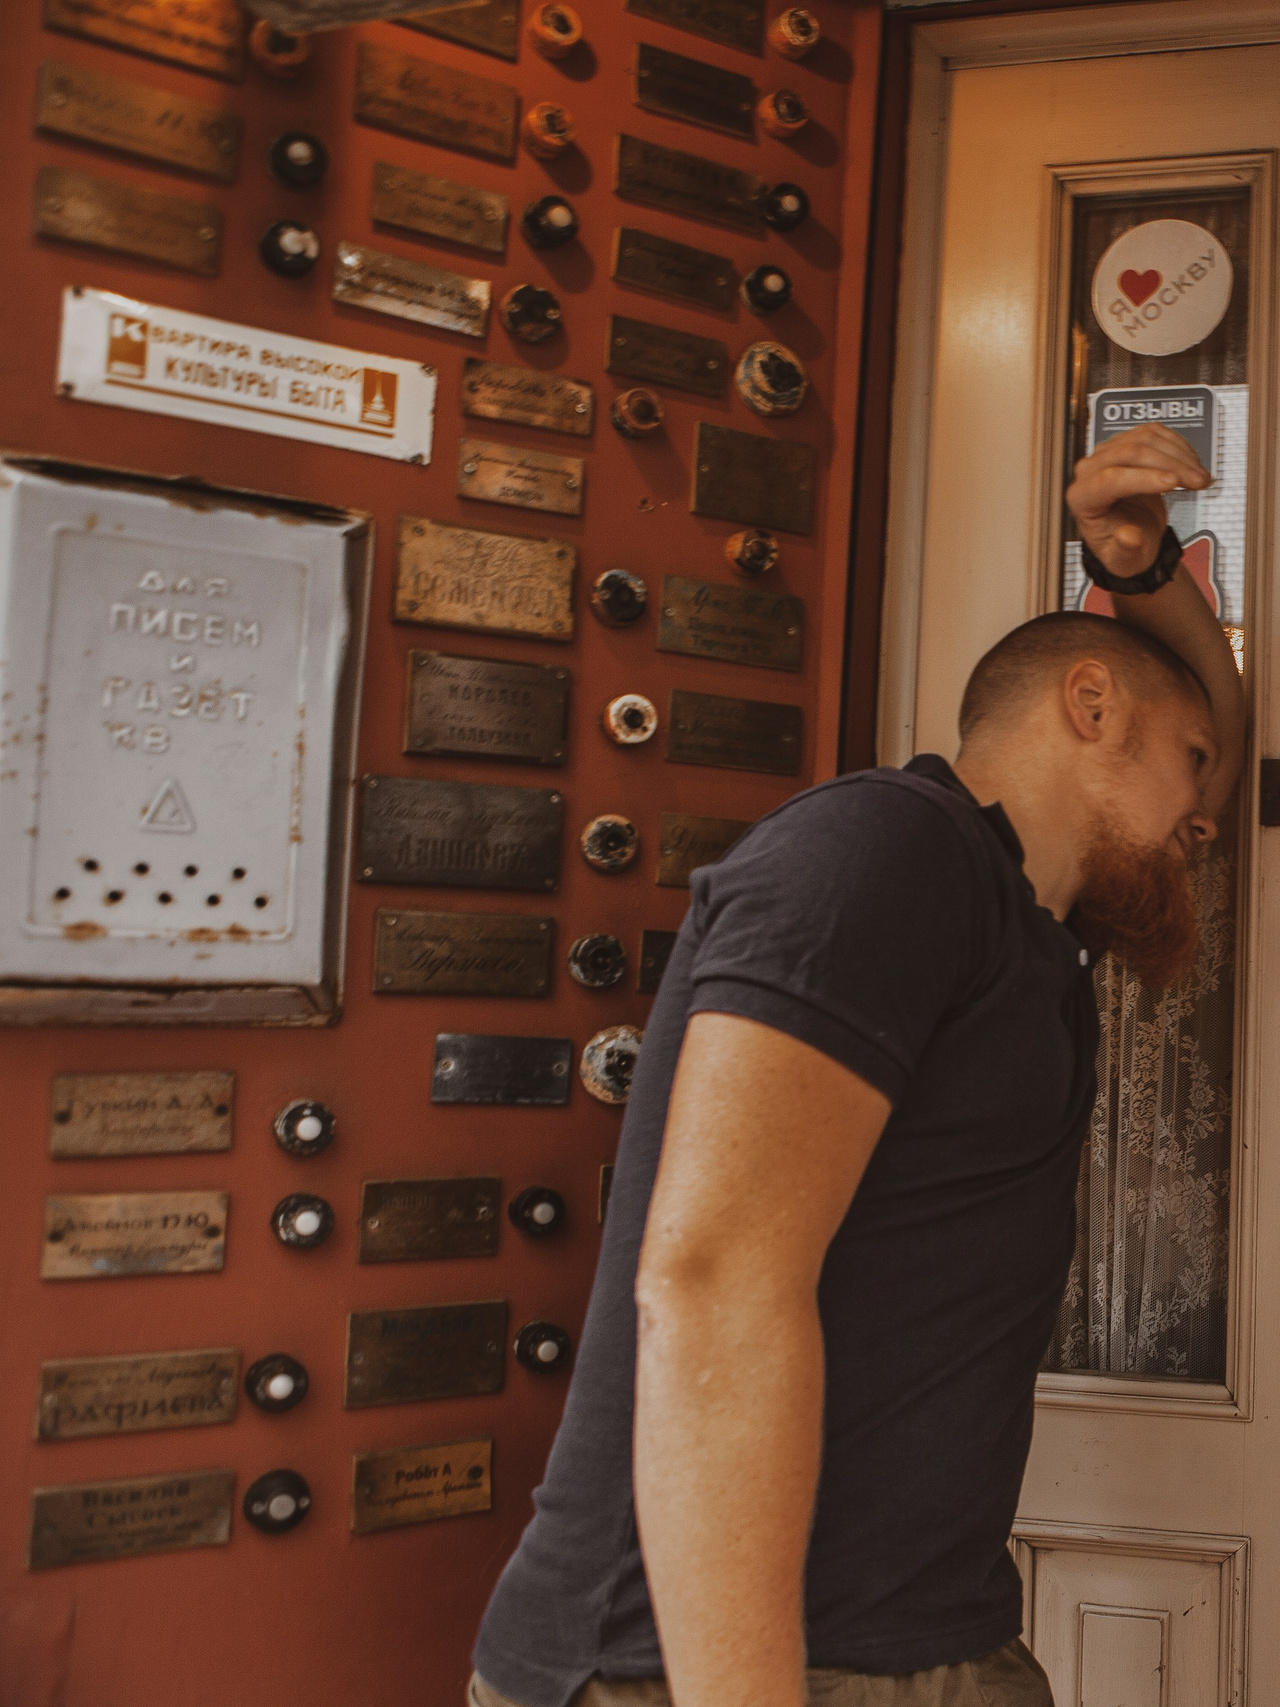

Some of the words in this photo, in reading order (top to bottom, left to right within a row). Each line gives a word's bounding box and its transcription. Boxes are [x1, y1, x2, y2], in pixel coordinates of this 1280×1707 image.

[1108, 298, 1132, 322] Я
[1122, 248, 1217, 338] МОСКВУ
[112, 318, 252, 361] КВАРТИРА
[164, 356, 279, 399] КУЛЬТУРЫ
[288, 379, 348, 413] БЫТА
[1102, 399, 1205, 421] ОТЗЫВЫ
[109, 602, 262, 647] ПИСЕМ
